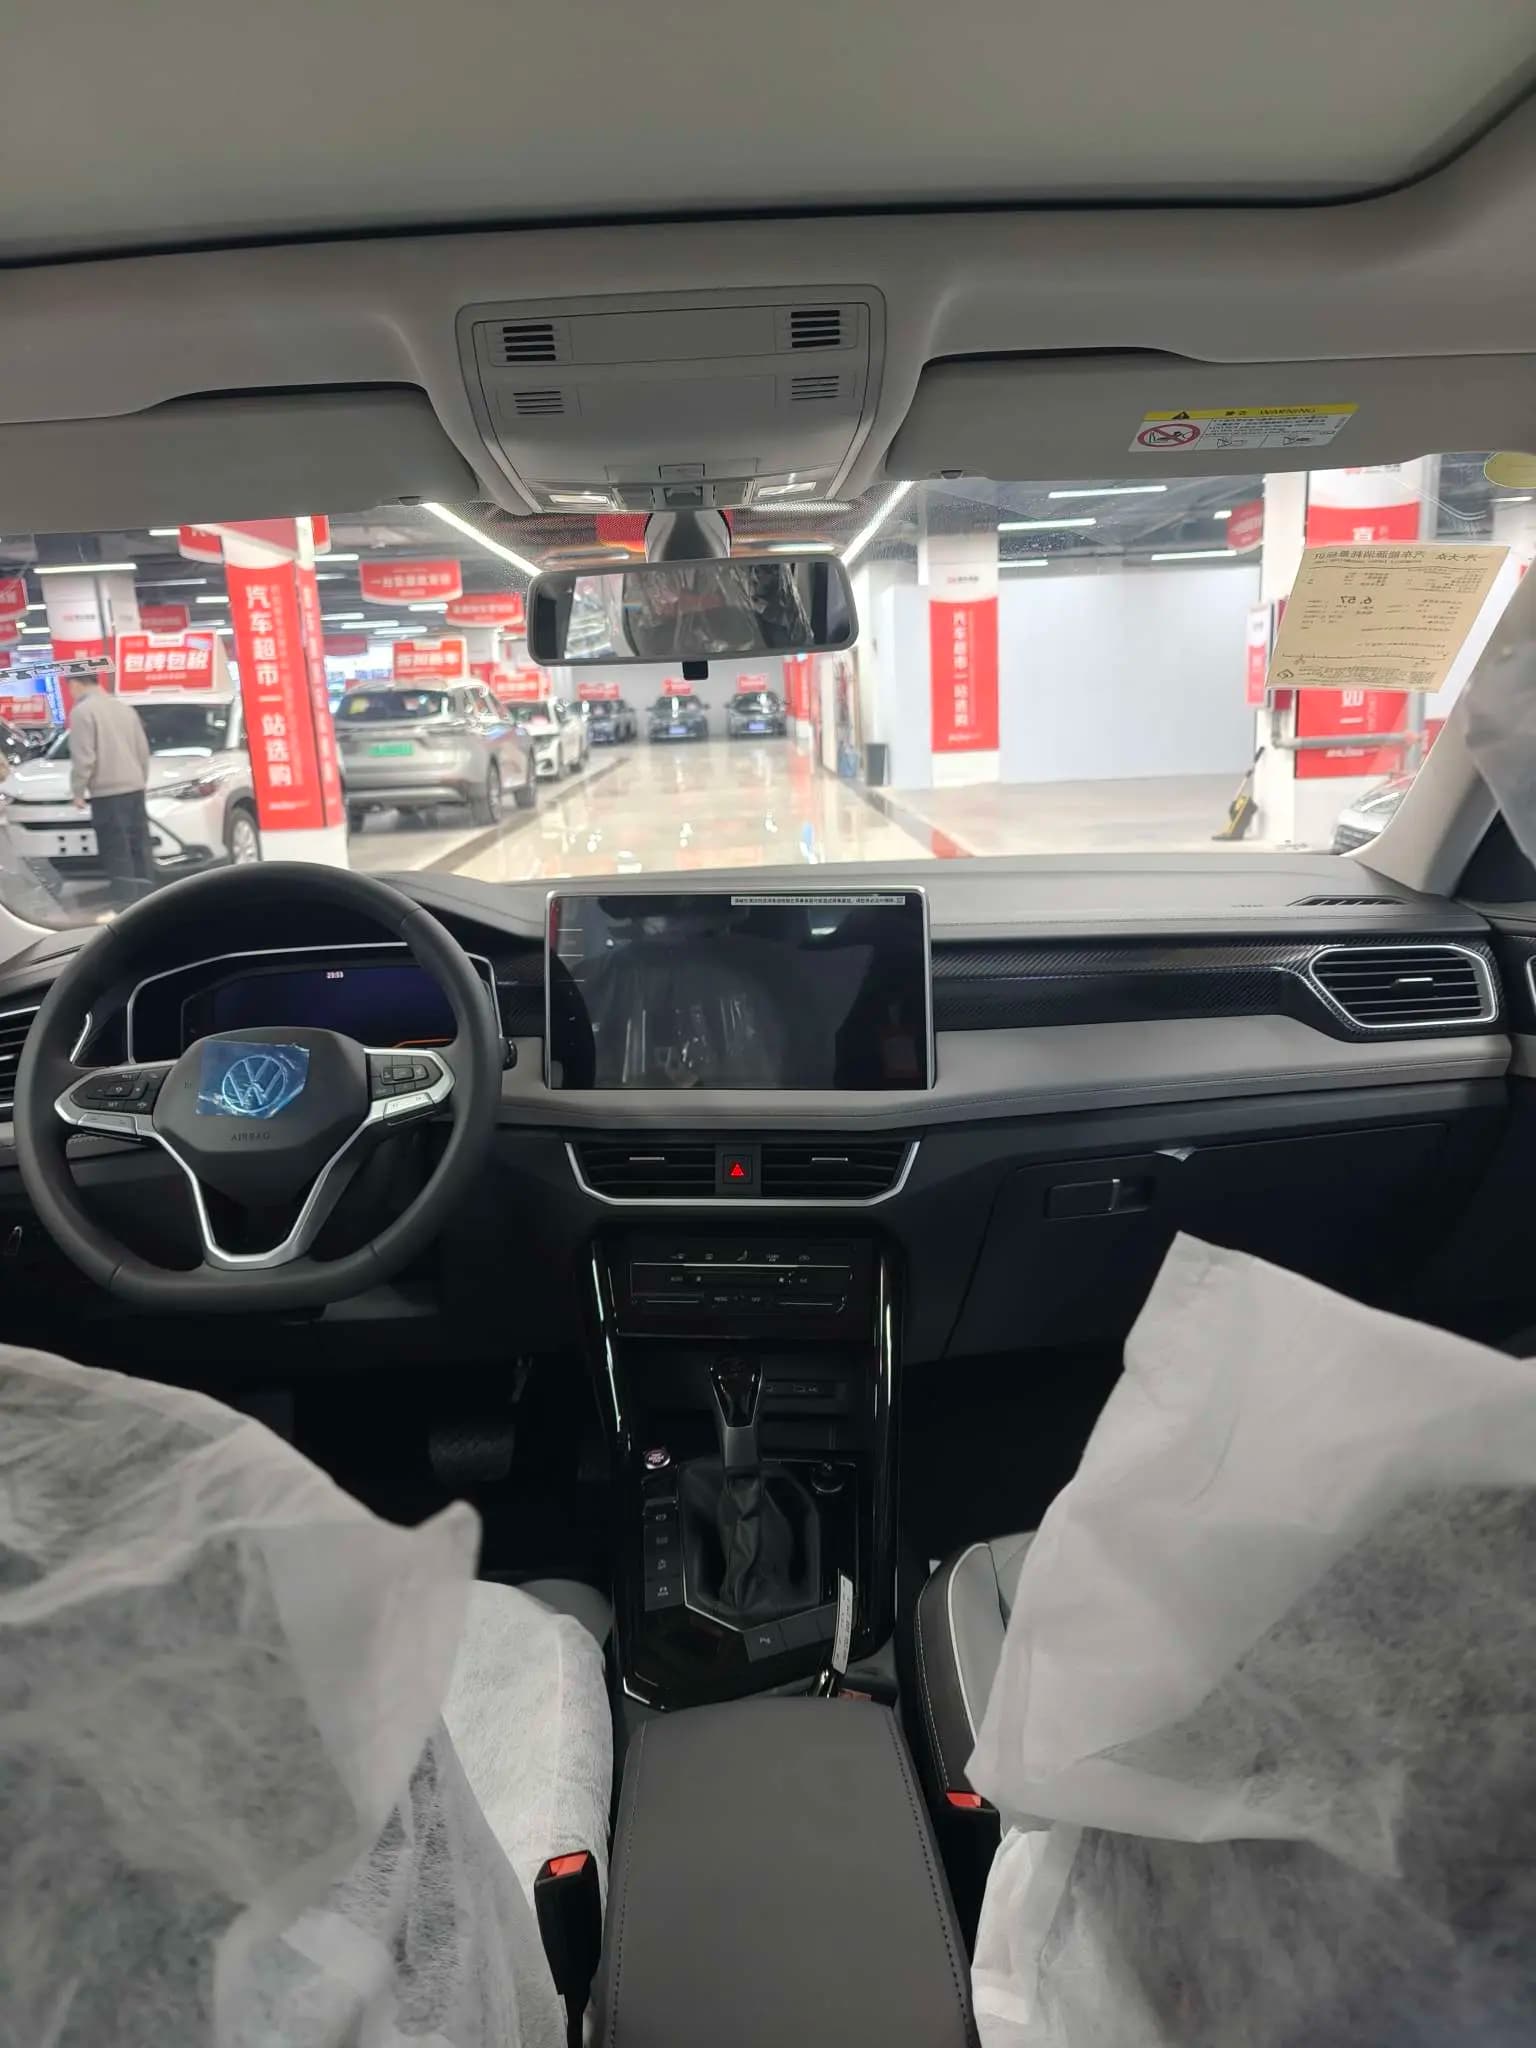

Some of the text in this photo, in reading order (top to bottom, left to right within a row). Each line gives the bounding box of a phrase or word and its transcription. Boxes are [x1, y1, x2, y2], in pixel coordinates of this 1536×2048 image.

[245, 584, 293, 787] 汽车超市一站选购
[231, 1131, 271, 1142] AIRBAG
